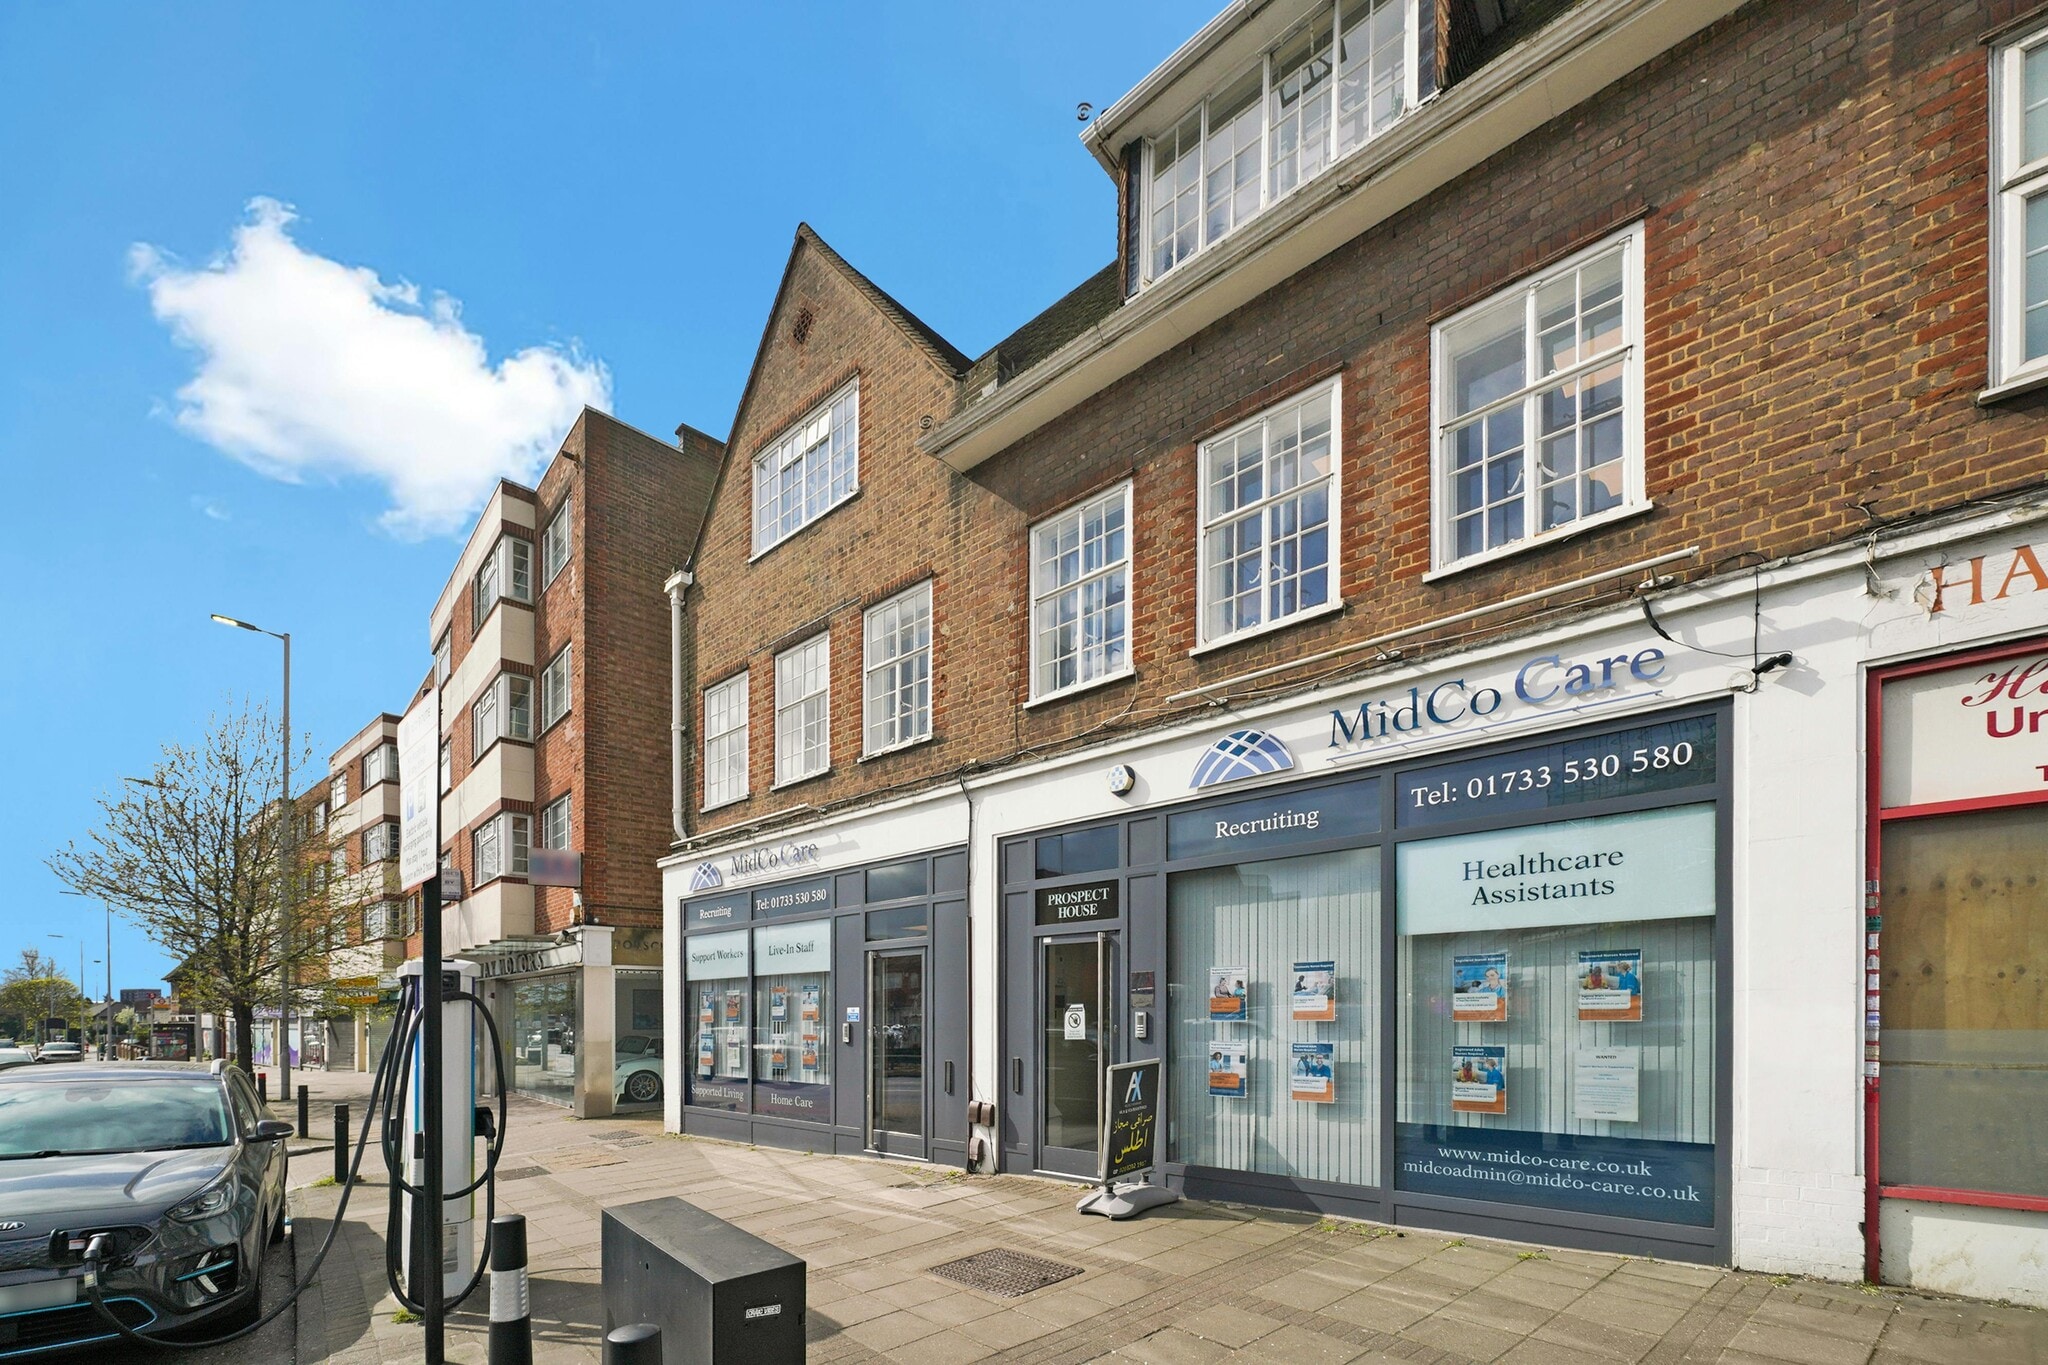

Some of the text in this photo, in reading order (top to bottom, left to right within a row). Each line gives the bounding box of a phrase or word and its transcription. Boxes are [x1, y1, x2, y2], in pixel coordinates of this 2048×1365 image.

[1328, 648, 1665, 747] MidCo Care
[1411, 743, 1693, 807] Tel: 01733 530 580
[1215, 810, 1319, 838] Recruiting
[731, 841, 819, 876] MidCo Care
[1463, 851, 1623, 881] Healthcare
[756, 888, 827, 911] Tel: 01733 530 580
[1048, 888, 1109, 906] PROSPECT
[1471, 878, 1614, 905] Assistants
[700, 906, 732, 919] Recruiting
[1058, 903, 1098, 918] HOUSE
[691, 950, 744, 964] Support Workers
[768, 940, 815, 956] Live-In Staff
[691, 1084, 744, 1102] Supported Living
[771, 1093, 813, 1108] Home Care
[1437, 1148, 1652, 1177] www.midco-care.co.uk
[1403, 1160, 1700, 1201] midcoadmin@midco-care.co.uk
